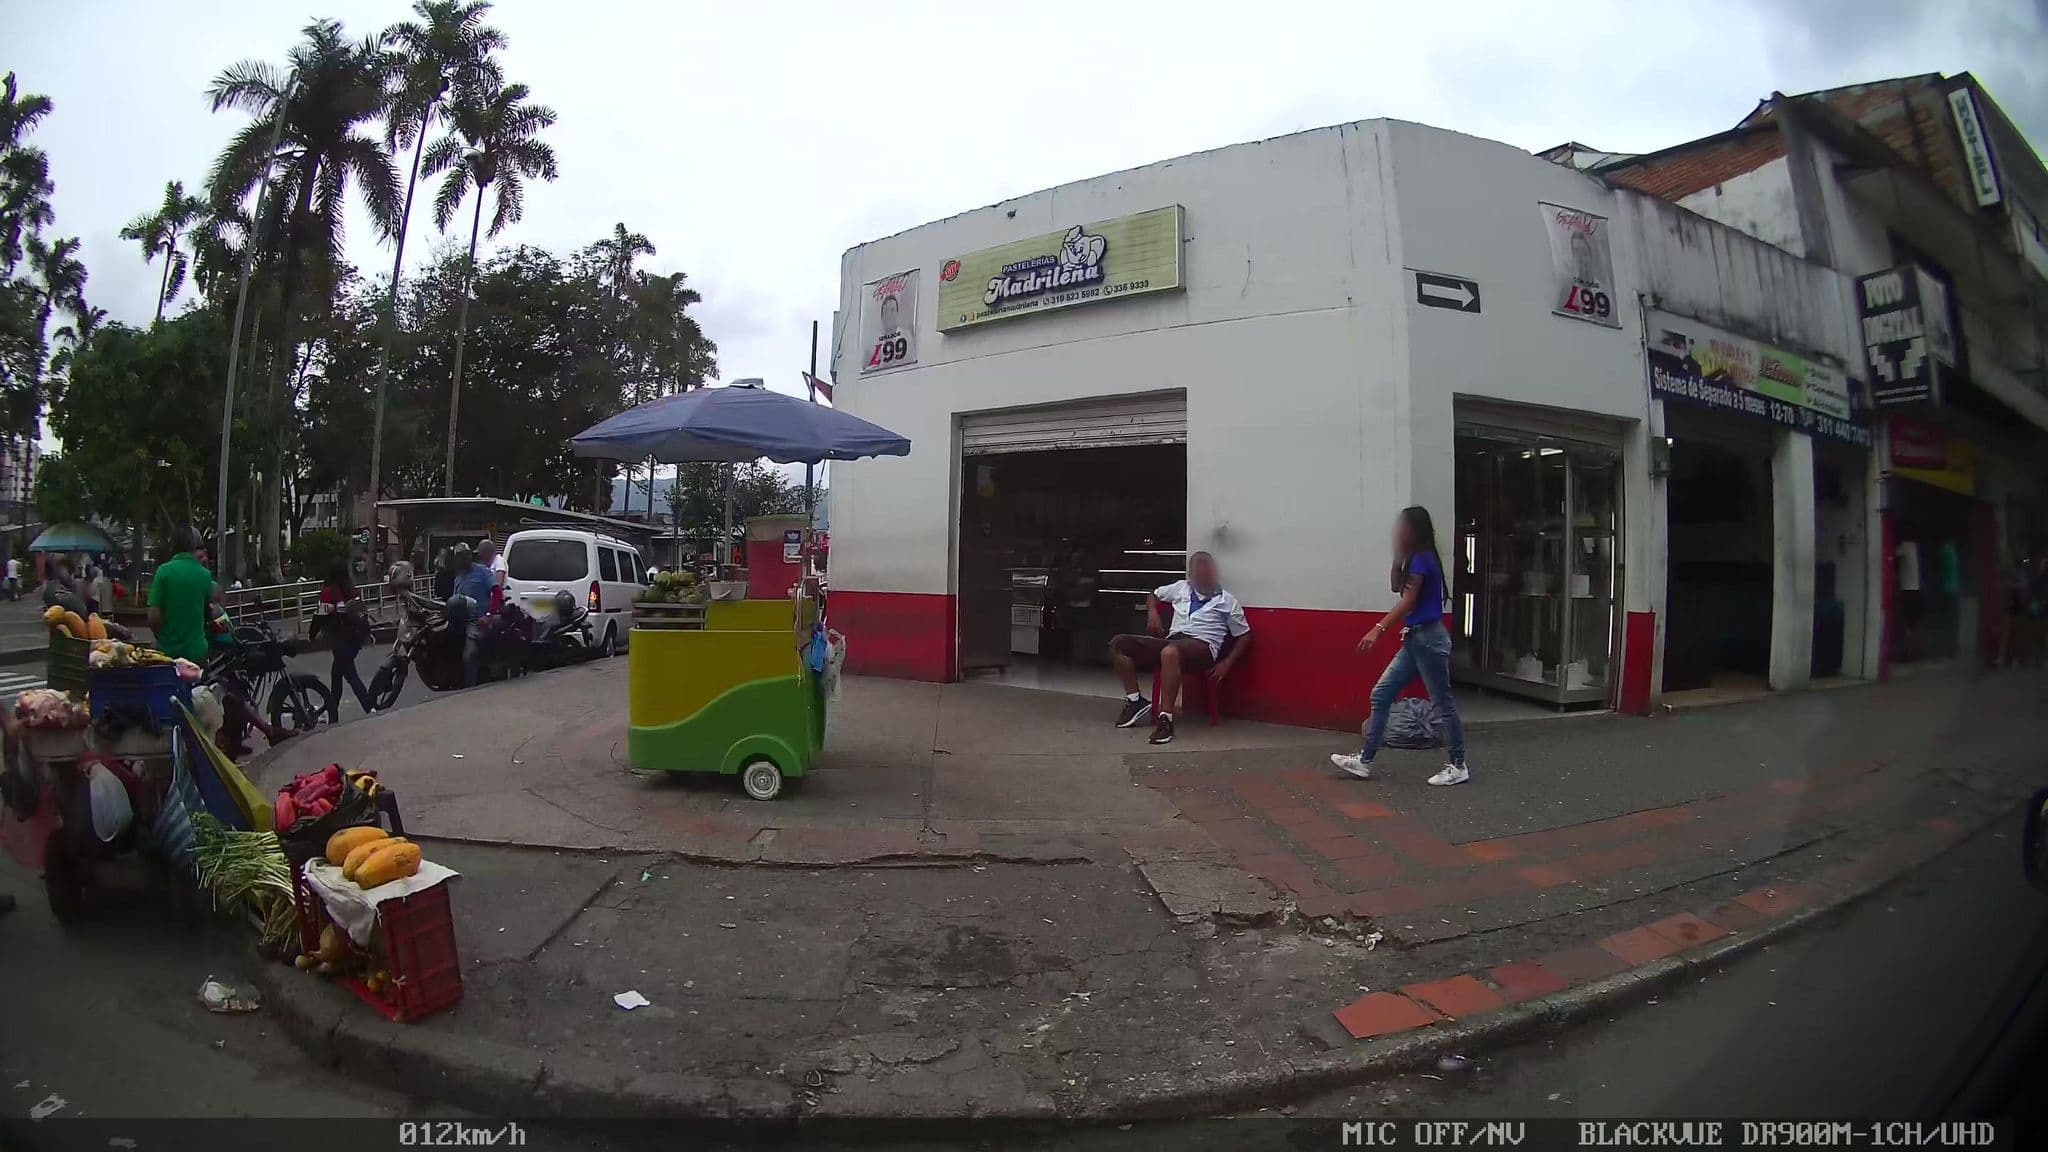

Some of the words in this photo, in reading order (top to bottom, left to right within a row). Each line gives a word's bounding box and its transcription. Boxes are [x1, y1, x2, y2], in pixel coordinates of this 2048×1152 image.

[1956, 95, 1993, 195] HOTEL
[984, 264, 1100, 304] Madrileña
[1563, 285, 1611, 318] L99
[870, 338, 908, 366] L99
[1654, 366, 1688, 396] Sistema
[1688, 376, 1699, 399] de
[1699, 380, 1733, 408] Separado
